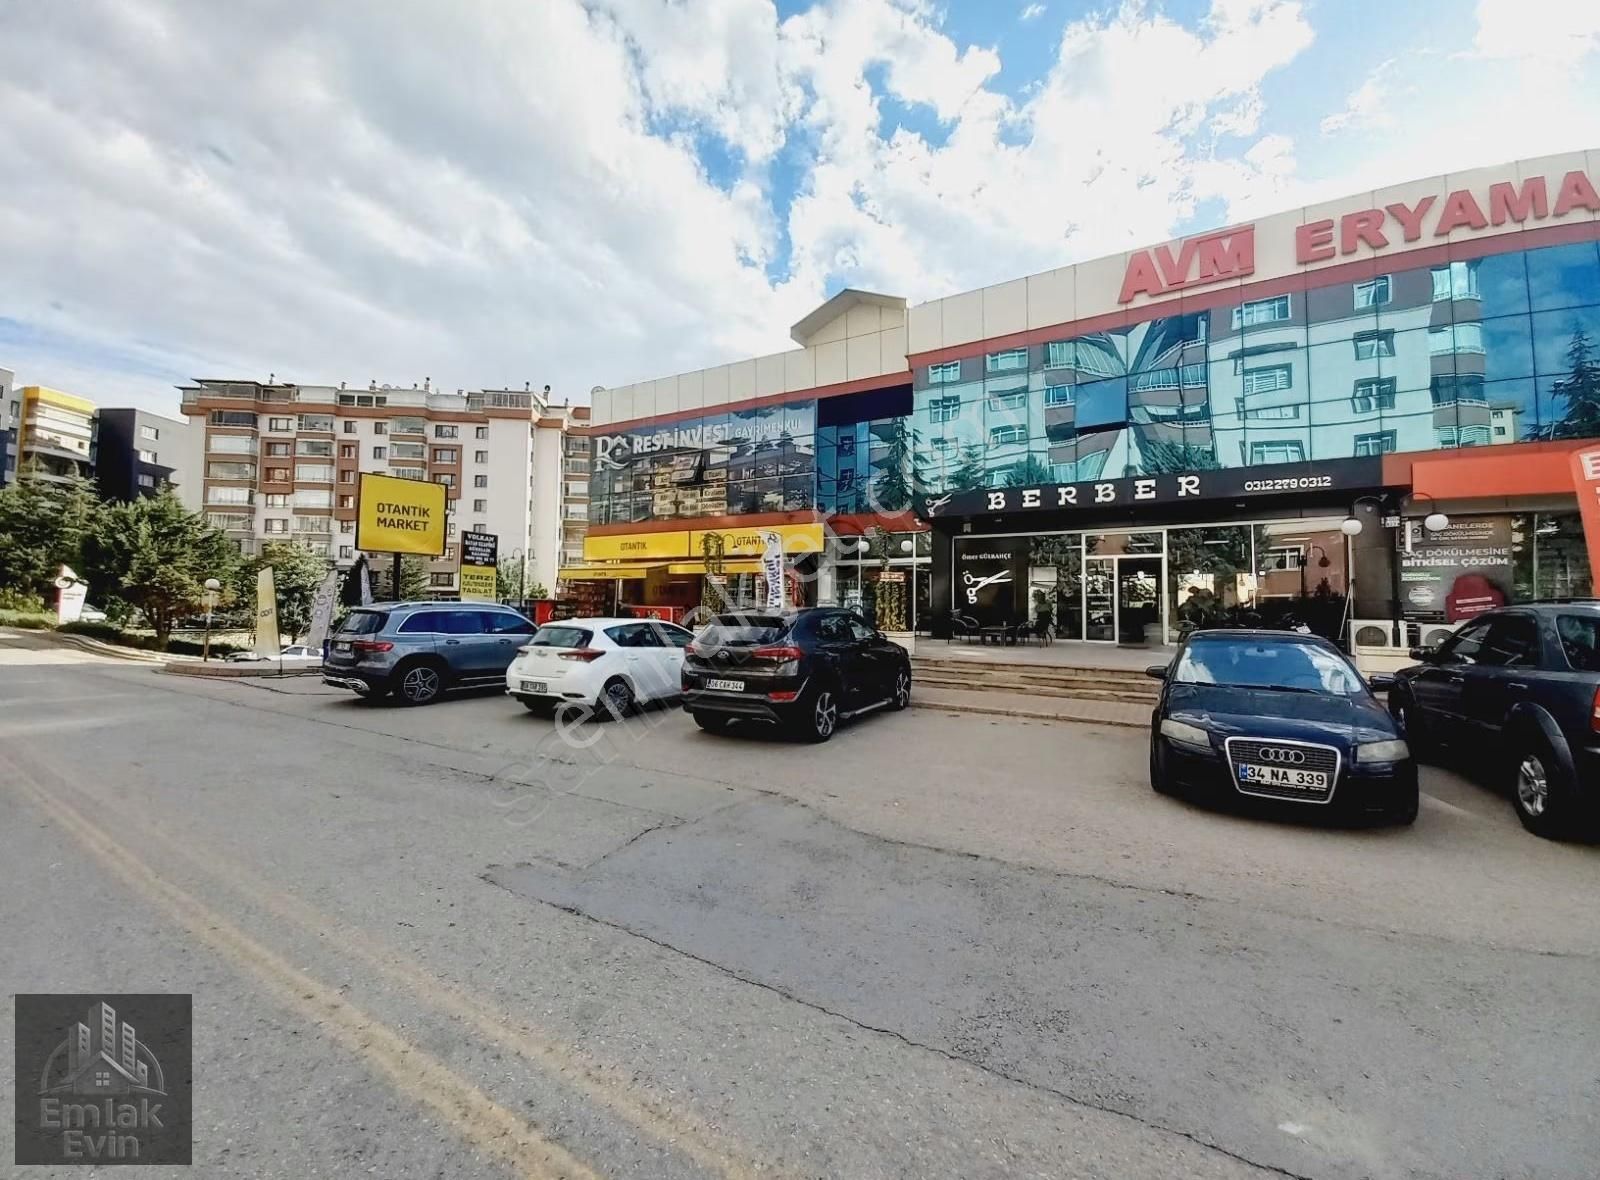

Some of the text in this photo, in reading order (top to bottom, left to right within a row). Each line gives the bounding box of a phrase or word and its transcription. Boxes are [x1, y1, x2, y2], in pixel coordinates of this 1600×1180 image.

[1118, 224, 1255, 303] AVM
[1244, 476, 1331, 491] 0312 279 0312
[987, 475, 1200, 510] BERBER
[377, 502, 430, 518] OTANTİK
[377, 517, 429, 531] MARKET
[1426, 546, 1509, 557] DÖKÜLMESİNE
[1461, 556, 1509, 567] ÇÖZÜM
[1247, 766, 1265, 779] 34
[1270, 769, 1290, 782] NA
[1296, 772, 1325, 786] 339
